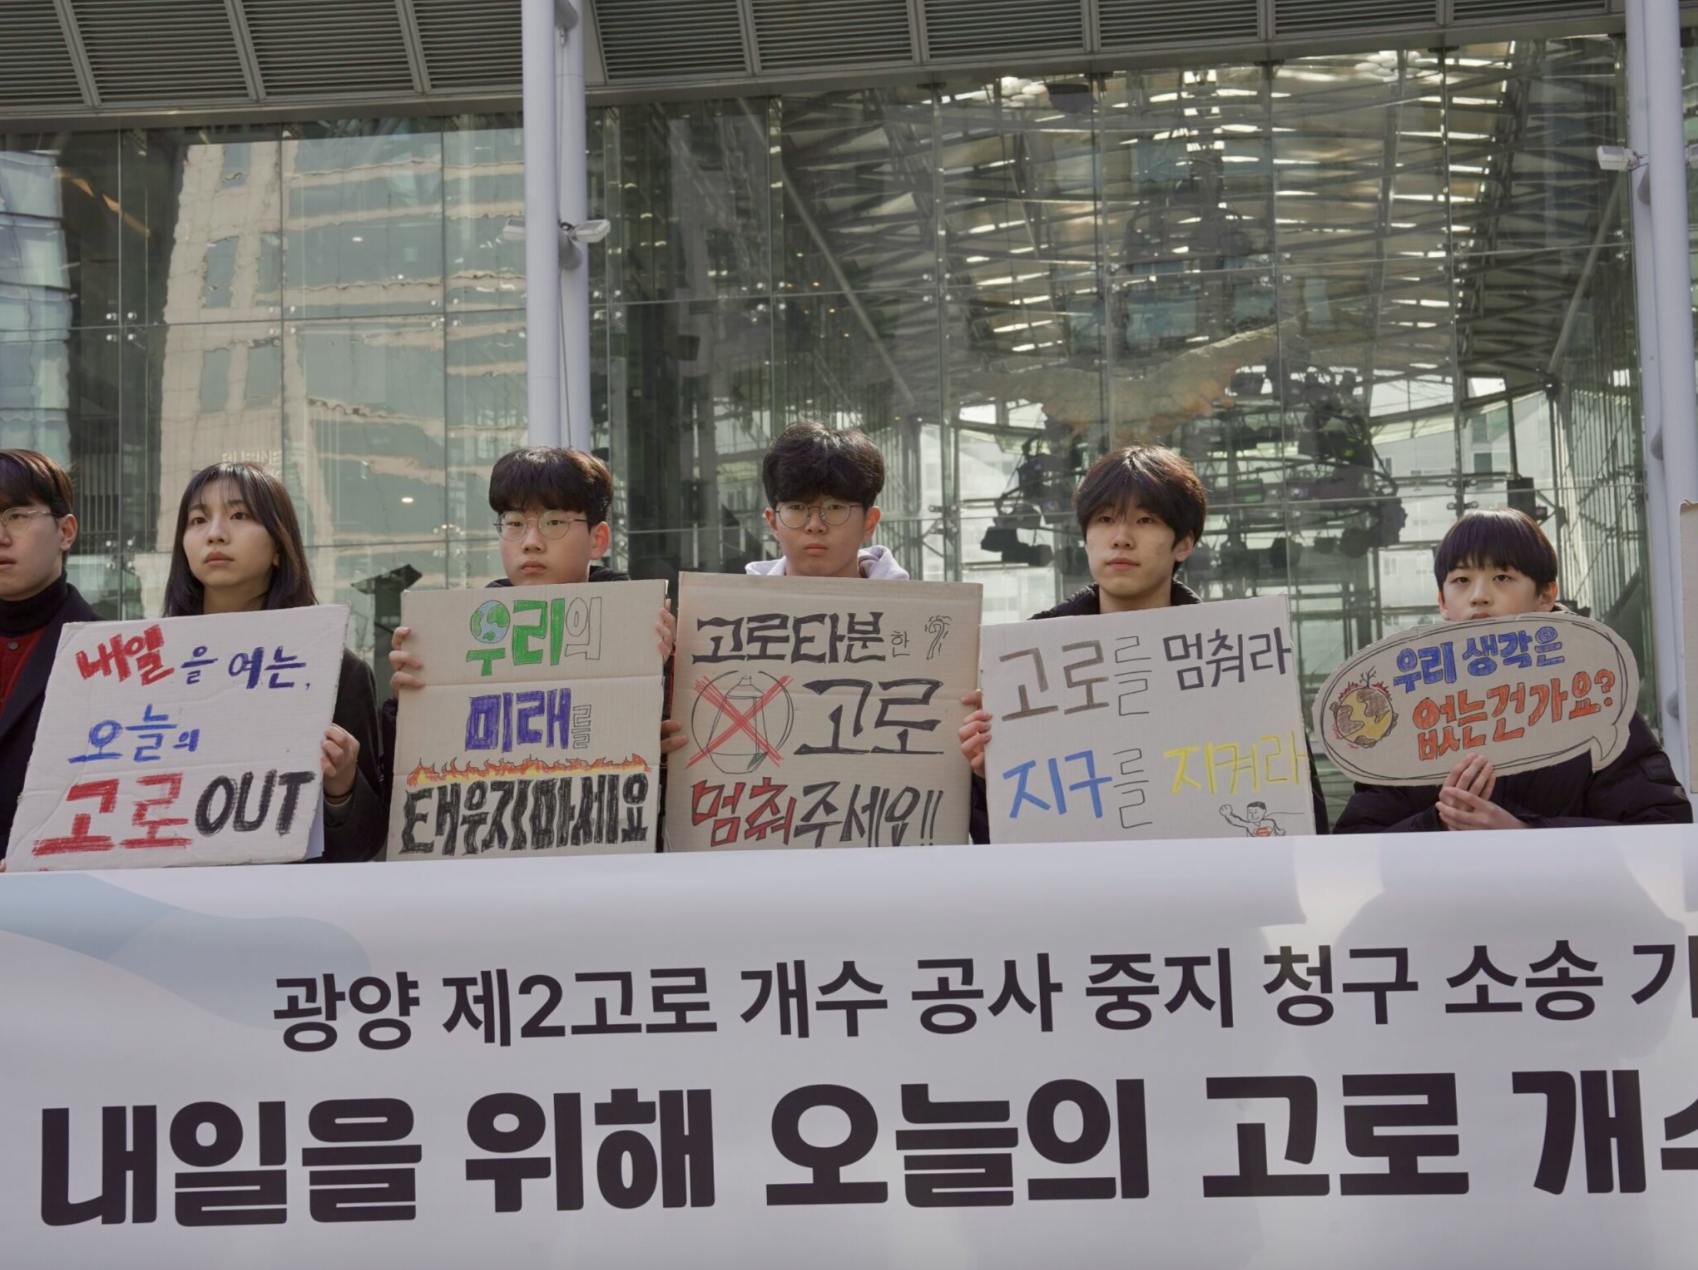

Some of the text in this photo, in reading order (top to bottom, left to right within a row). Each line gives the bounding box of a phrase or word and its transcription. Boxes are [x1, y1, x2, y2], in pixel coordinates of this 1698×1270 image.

[228, 646, 311, 690] 여는,
[465, 596, 603, 676] 우리의
[999, 627, 1292, 722] 고로를 멈춰라
[1393, 626, 1566, 694] 우리 생각은
[68, 703, 200, 763] 오늘의
[464, 687, 592, 753] 미래를
[793, 678, 945, 756] 고로
[1412, 668, 1616, 761] 없는건가요?
[1002, 729, 1307, 830] 지구를 지켜라
[274, 972, 420, 1052] 광양
[443, 968, 717, 1046] 제2고로
[741, 960, 887, 1038] 개수
[912, 953, 1063, 1034] 공사
[1086, 948, 1233, 1030] 중지
[1263, 946, 1418, 1026] 청구
[1445, 940, 1603, 1020] 소송
[41, 1098, 422, 1227] 내일을
[466, 1088, 715, 1212] 위해
[766, 1079, 1149, 1207] 오늘의
[1203, 1073, 1469, 1197] 고로
